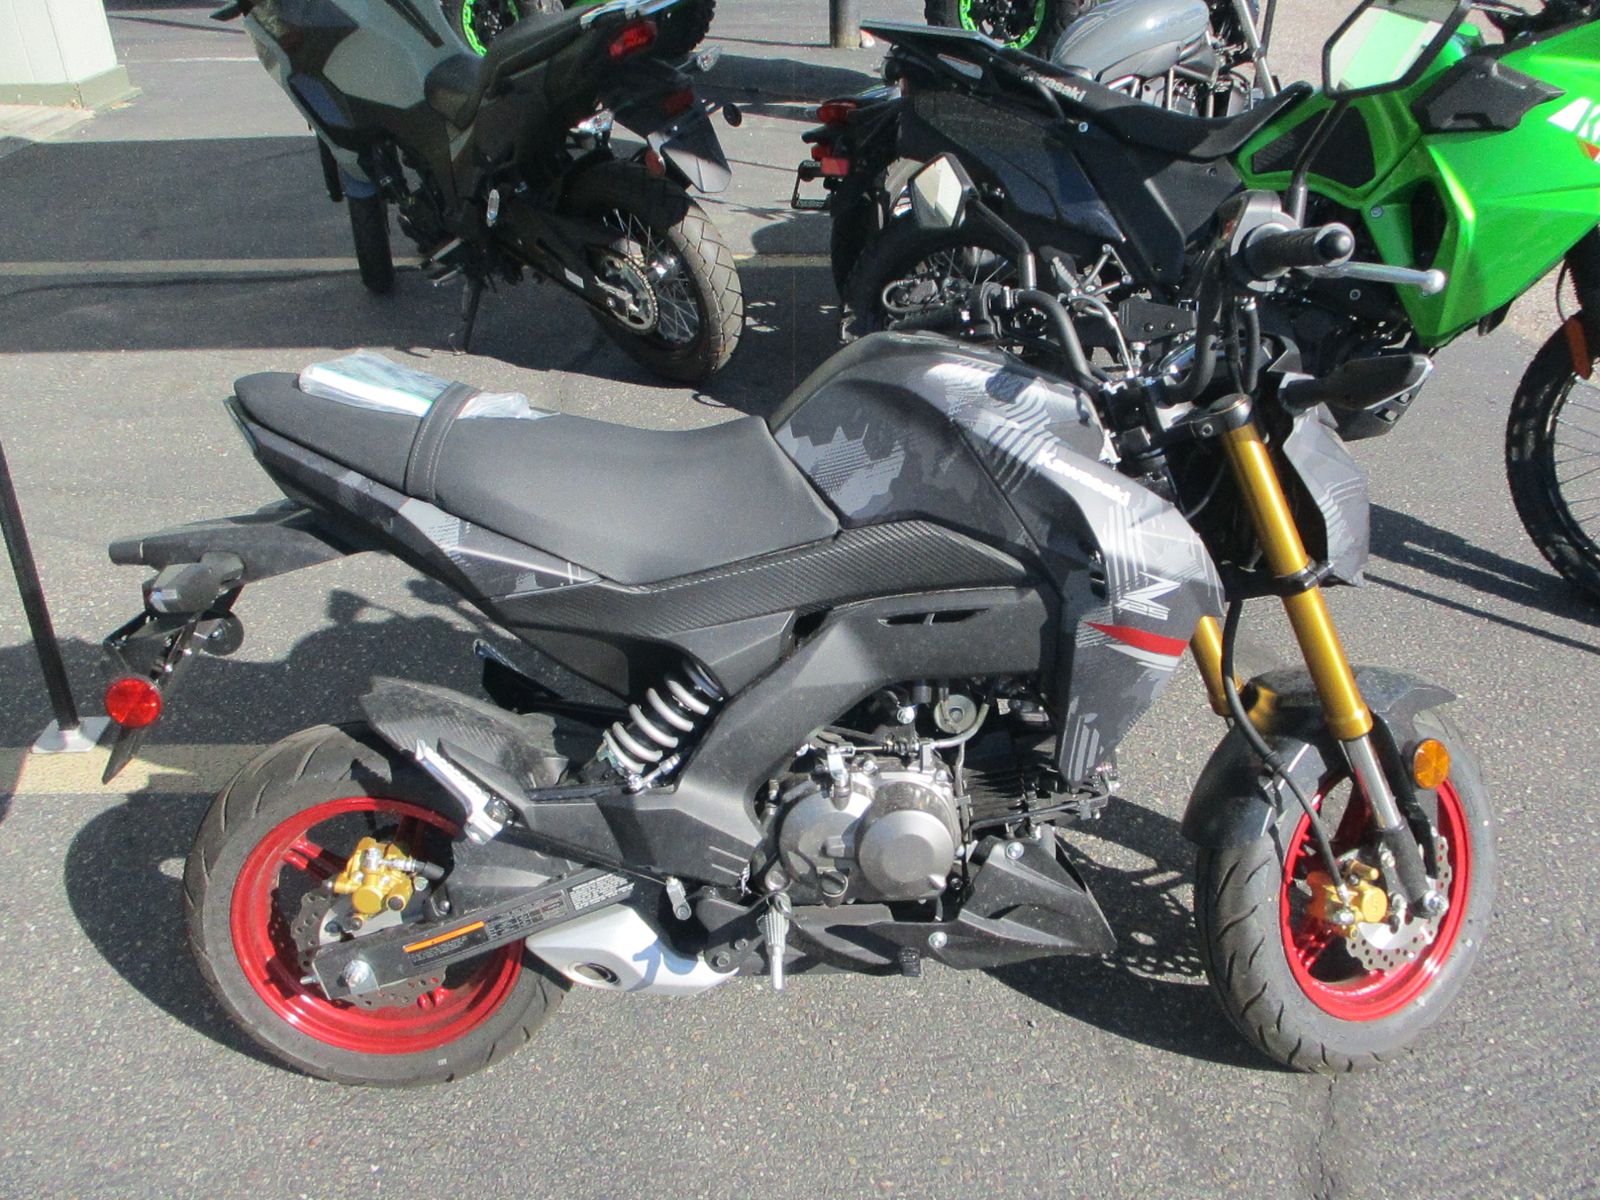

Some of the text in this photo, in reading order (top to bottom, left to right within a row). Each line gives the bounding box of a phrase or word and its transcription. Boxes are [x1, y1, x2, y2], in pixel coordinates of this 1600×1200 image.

[1037, 447, 1131, 506] Kawasaki
[1114, 599, 1169, 621] 125
[1120, 571, 1182, 611] Z
